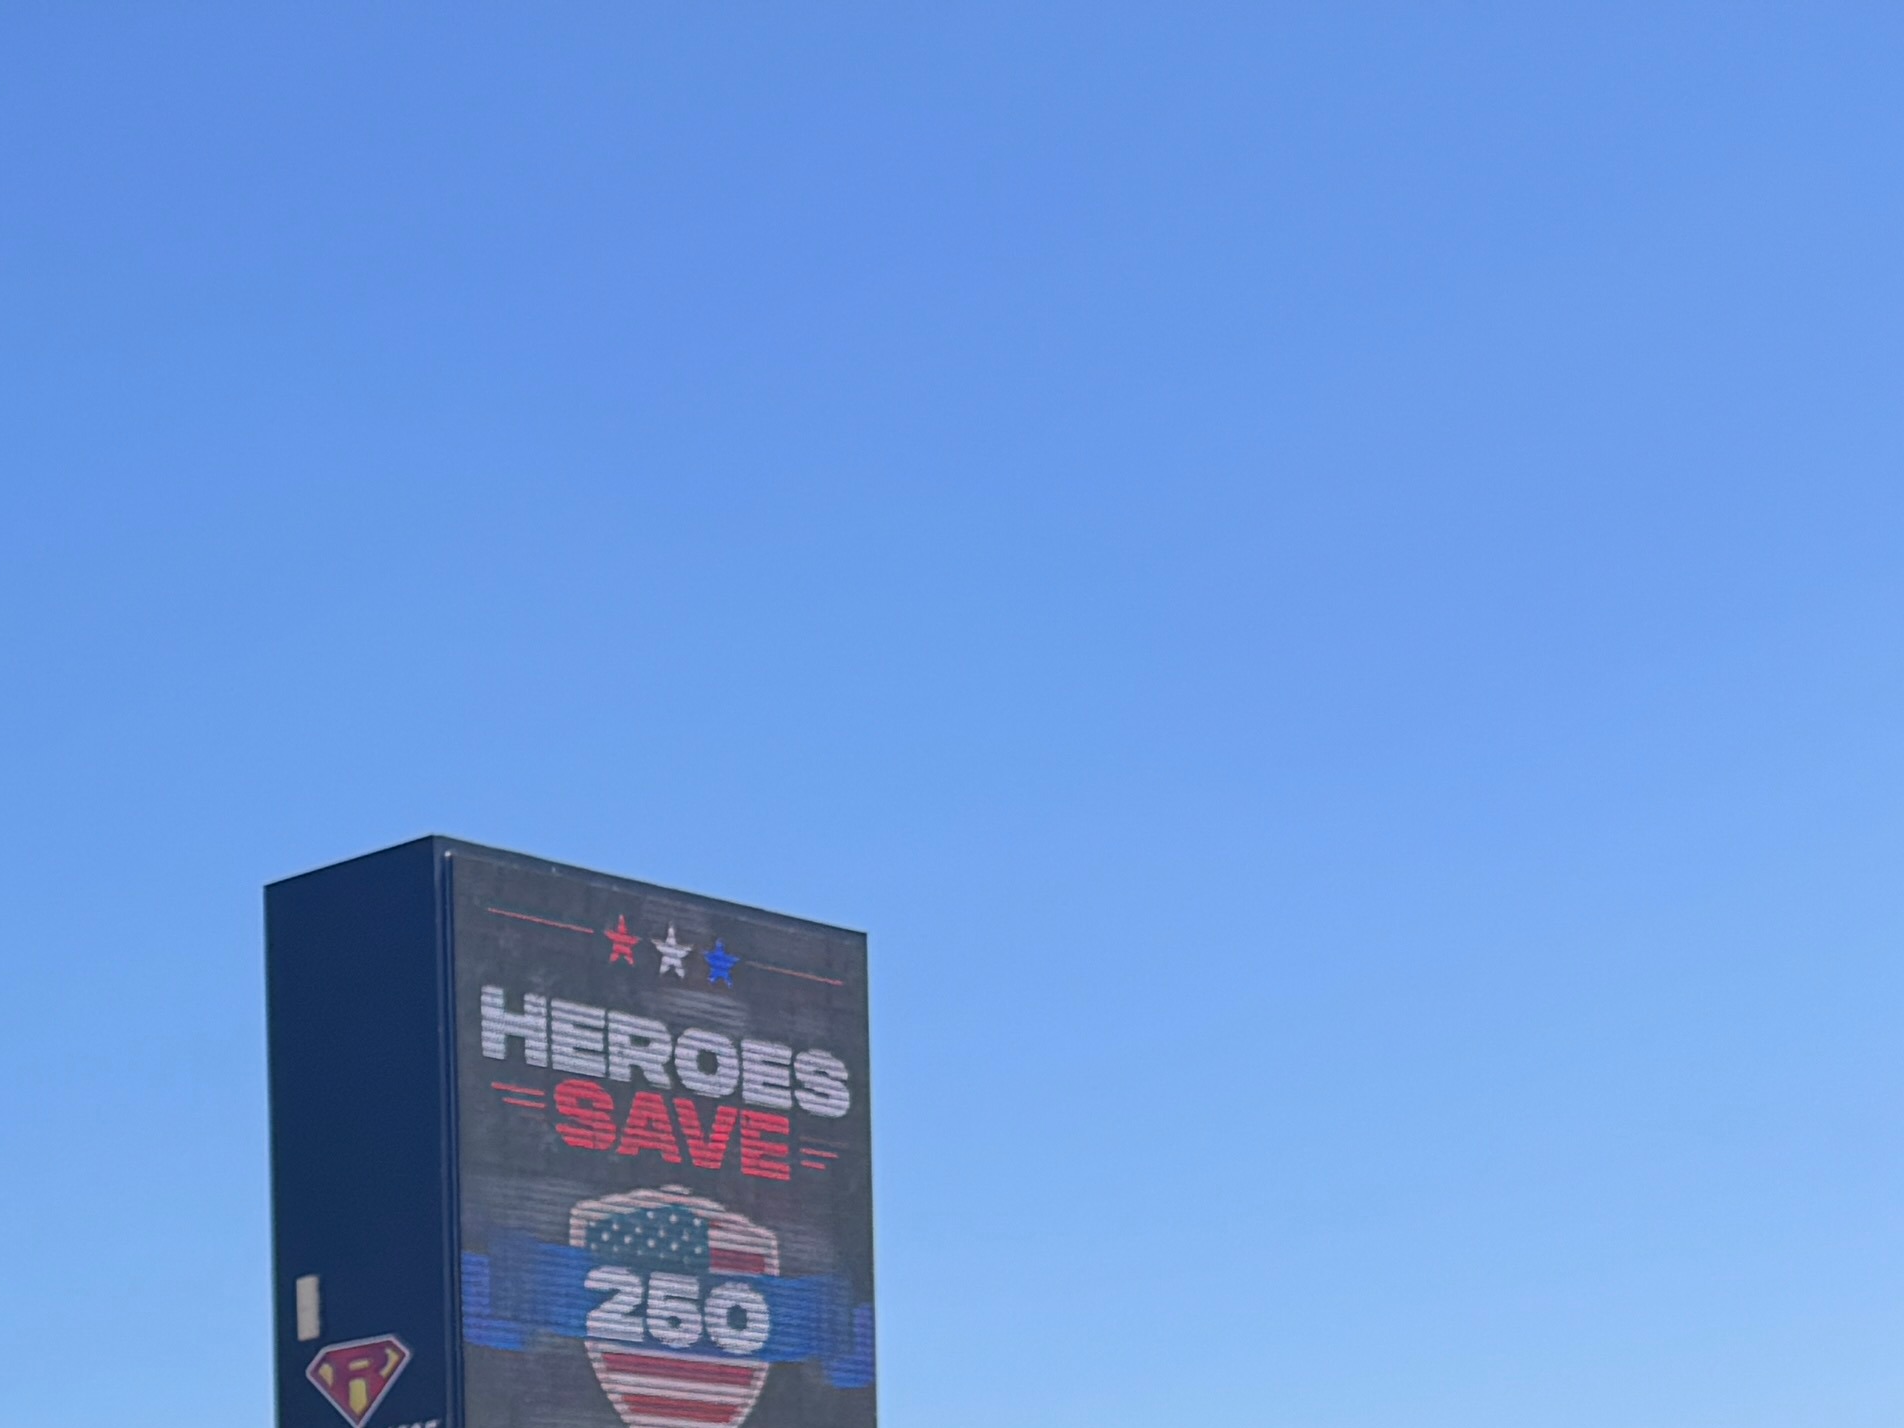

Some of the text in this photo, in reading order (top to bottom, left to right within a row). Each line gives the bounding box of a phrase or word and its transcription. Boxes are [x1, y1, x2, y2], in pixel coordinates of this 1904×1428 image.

[480, 984, 852, 1118] HEROES
[553, 1078, 792, 1181] SAVE
[583, 1265, 771, 1356] 250
